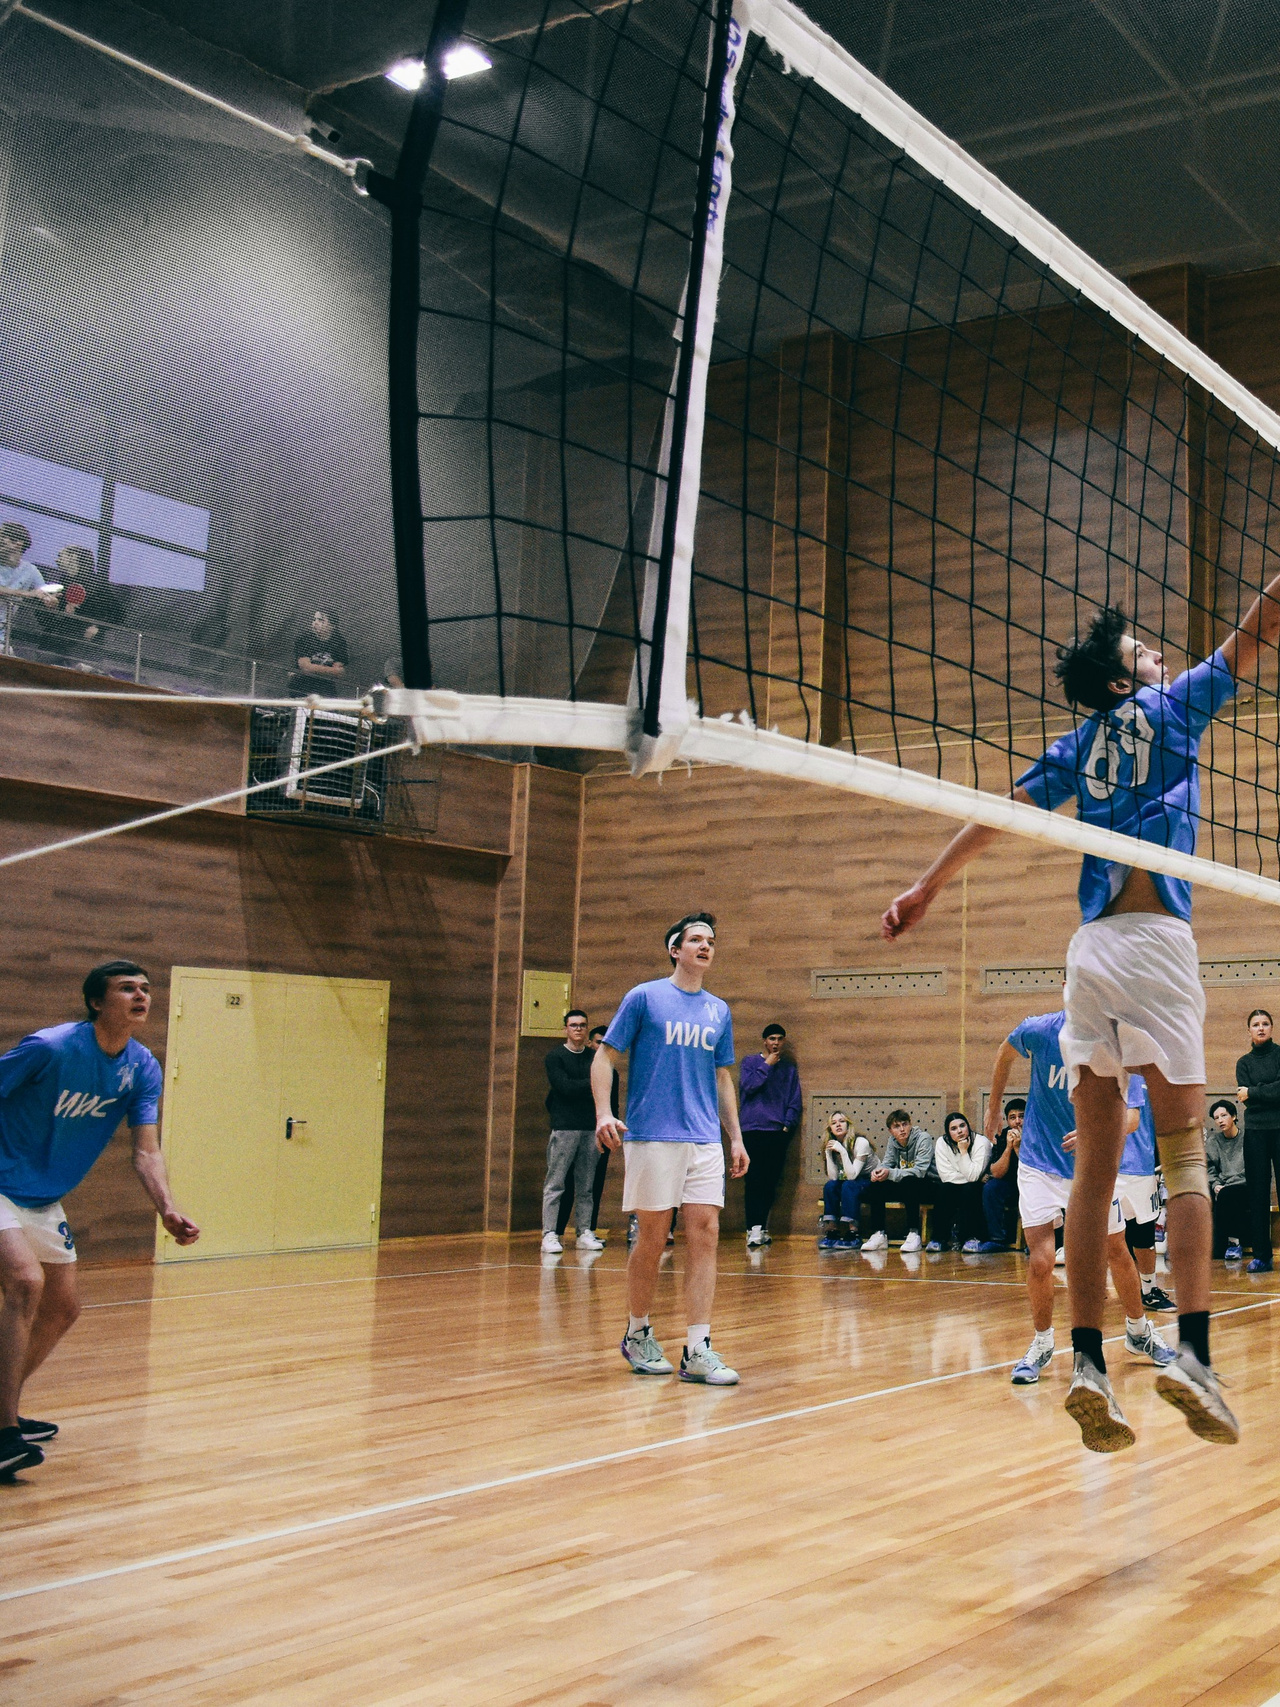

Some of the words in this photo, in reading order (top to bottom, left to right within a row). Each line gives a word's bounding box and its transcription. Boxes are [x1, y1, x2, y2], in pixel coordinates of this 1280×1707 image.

[230, 996, 240, 1005] 22
[666, 1020, 716, 1050] ИИС
[54, 1089, 118, 1118] ИИС
